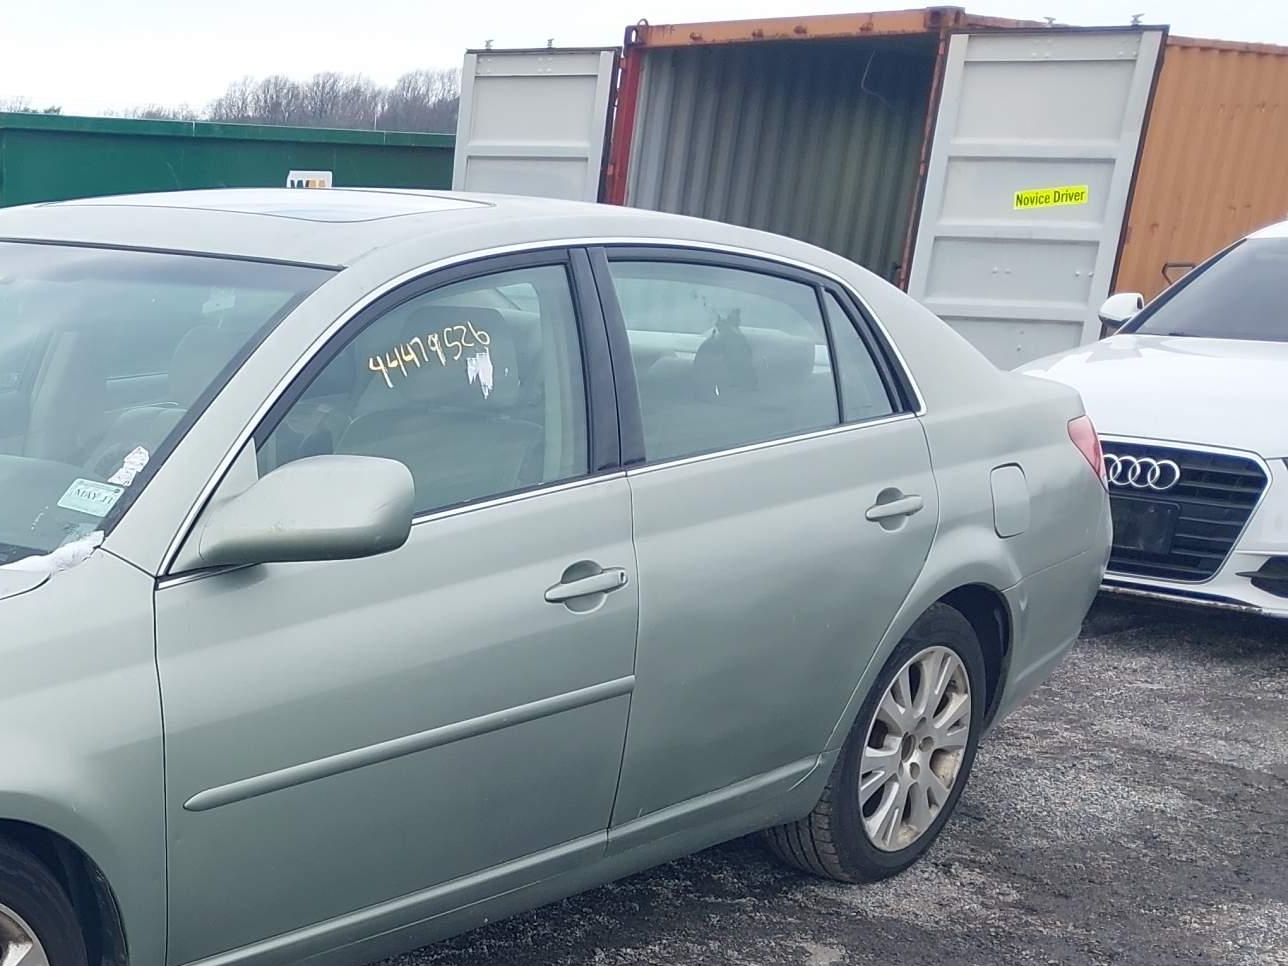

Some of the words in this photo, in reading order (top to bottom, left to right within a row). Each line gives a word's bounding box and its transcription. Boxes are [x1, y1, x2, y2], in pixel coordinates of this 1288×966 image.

[1015, 193, 1050, 207] Novice
[1053, 188, 1085, 203] Driver
[368, 321, 490, 388] 44479526
